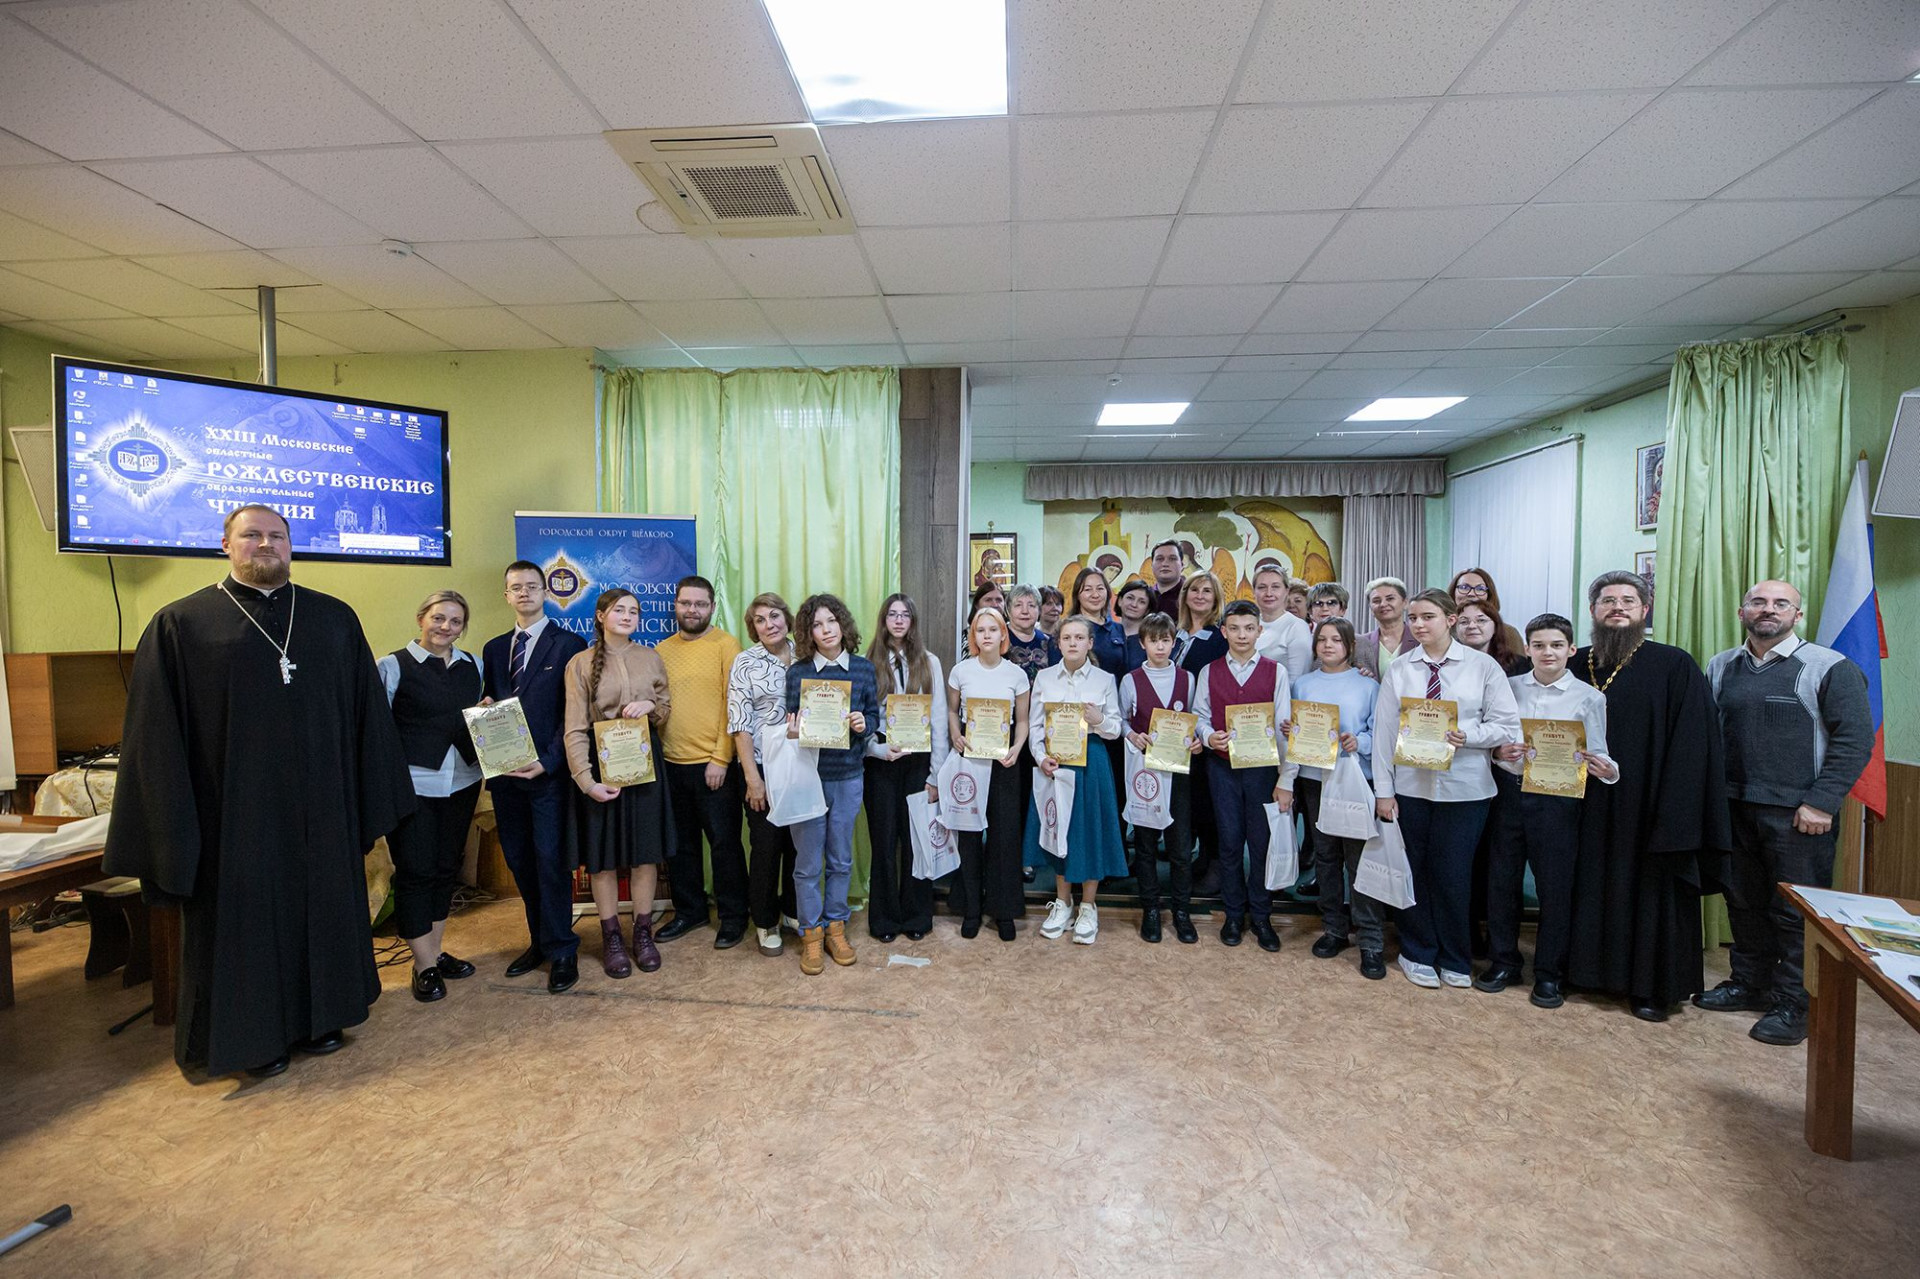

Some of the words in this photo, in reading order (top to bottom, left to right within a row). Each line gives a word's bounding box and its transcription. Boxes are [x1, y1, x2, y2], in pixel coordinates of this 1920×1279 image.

[205, 426, 257, 443] XXIII
[261, 433, 354, 455] Московские
[207, 462, 435, 495] РОЖДЕСТВЕНСКИЕ
[539, 527, 594, 537] ГОРОДСКОЙ
[598, 529, 628, 538] ОКРУГ
[632, 528, 674, 538] ЩЁЛКОВО
